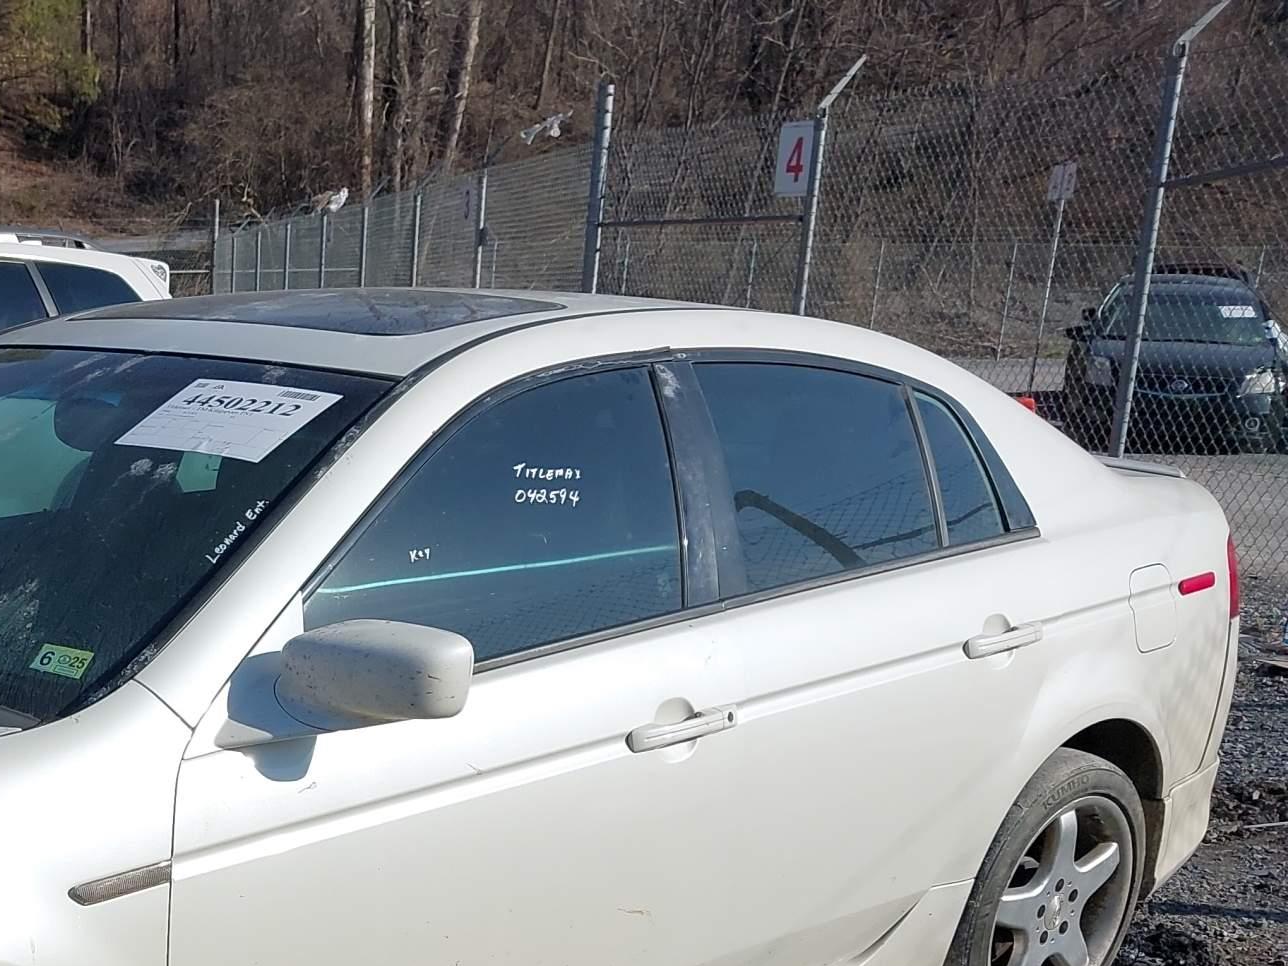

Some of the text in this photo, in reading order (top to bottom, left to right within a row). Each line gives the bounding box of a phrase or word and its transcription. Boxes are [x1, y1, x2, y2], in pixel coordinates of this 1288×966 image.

[785, 136, 804, 183] 4
[183, 393, 302, 417] 44502212
[514, 488, 580, 507] 042594
[39, 651, 88, 669] 6 25
[1042, 775, 1089, 810] KUMHO
